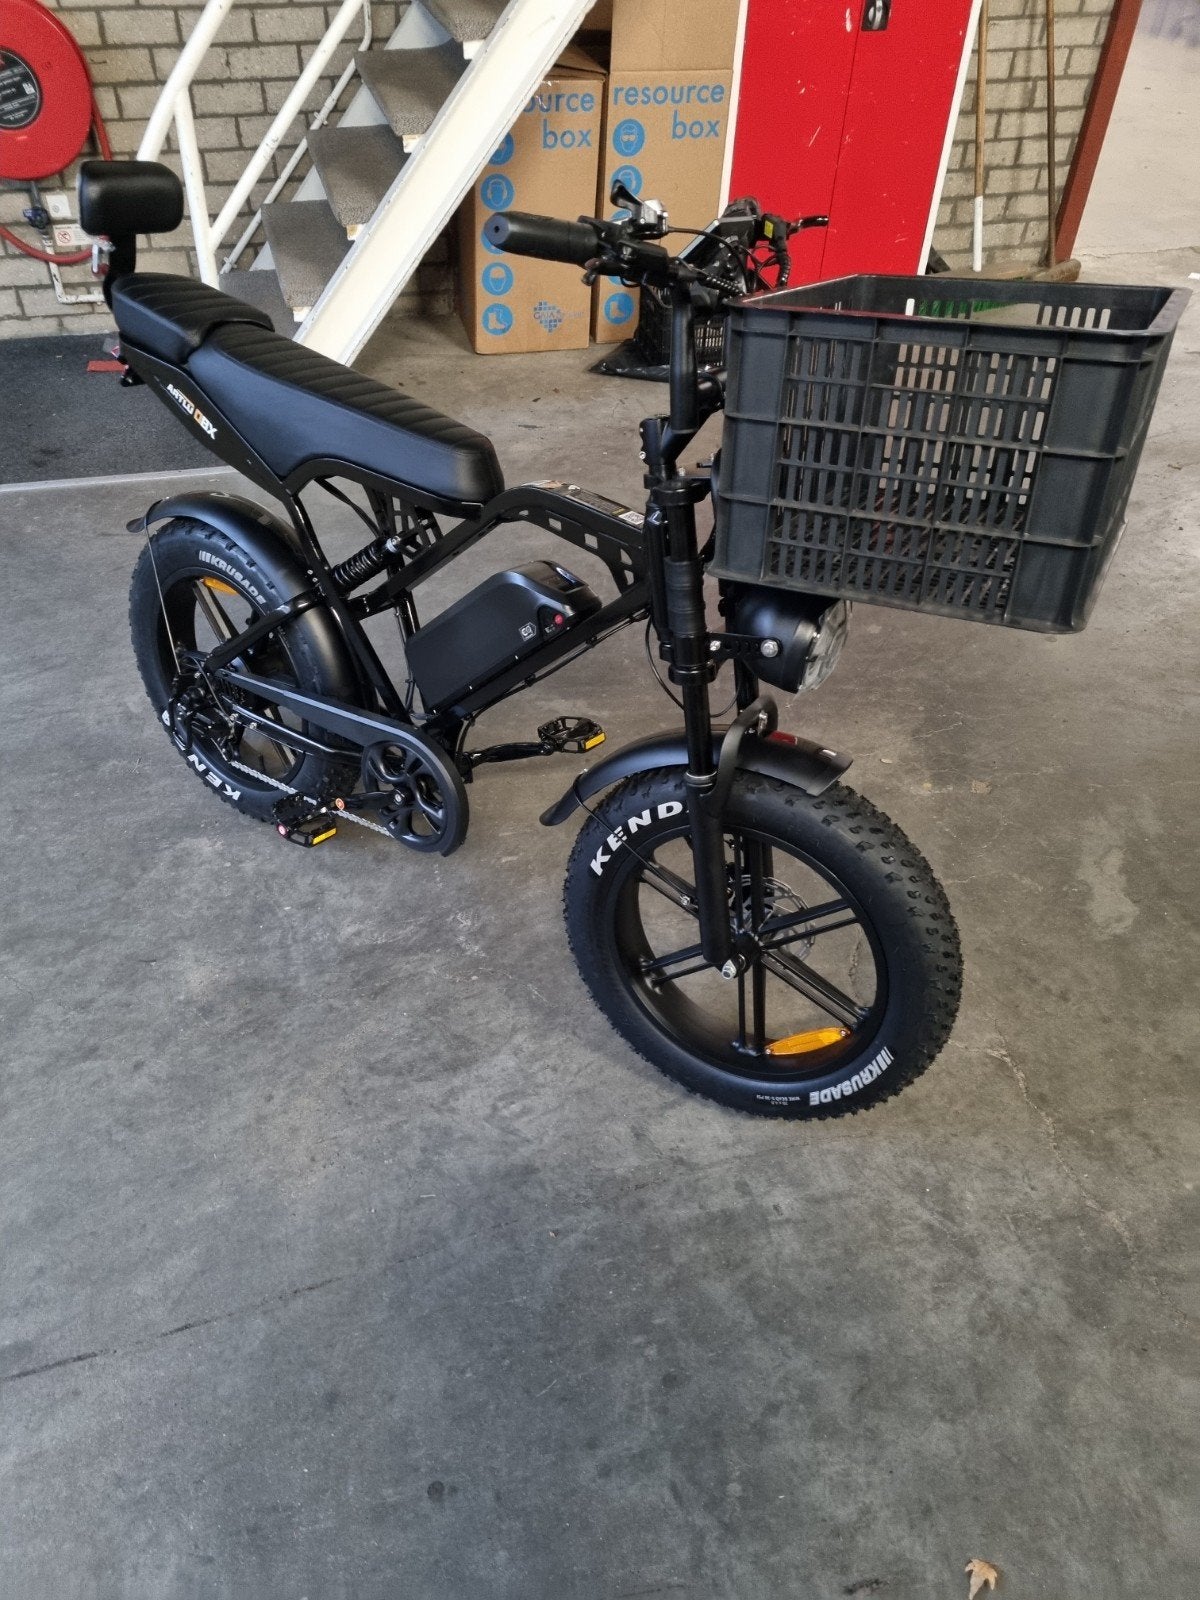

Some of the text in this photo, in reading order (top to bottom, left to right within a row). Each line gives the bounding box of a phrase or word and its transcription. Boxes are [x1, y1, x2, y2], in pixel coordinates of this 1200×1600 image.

[613, 84, 725, 106] resource
[543, 118, 592, 149] box
[671, 110, 720, 139] box
[589, 801, 690, 877] KEND
[809, 1058, 883, 1106] KRUSADE
